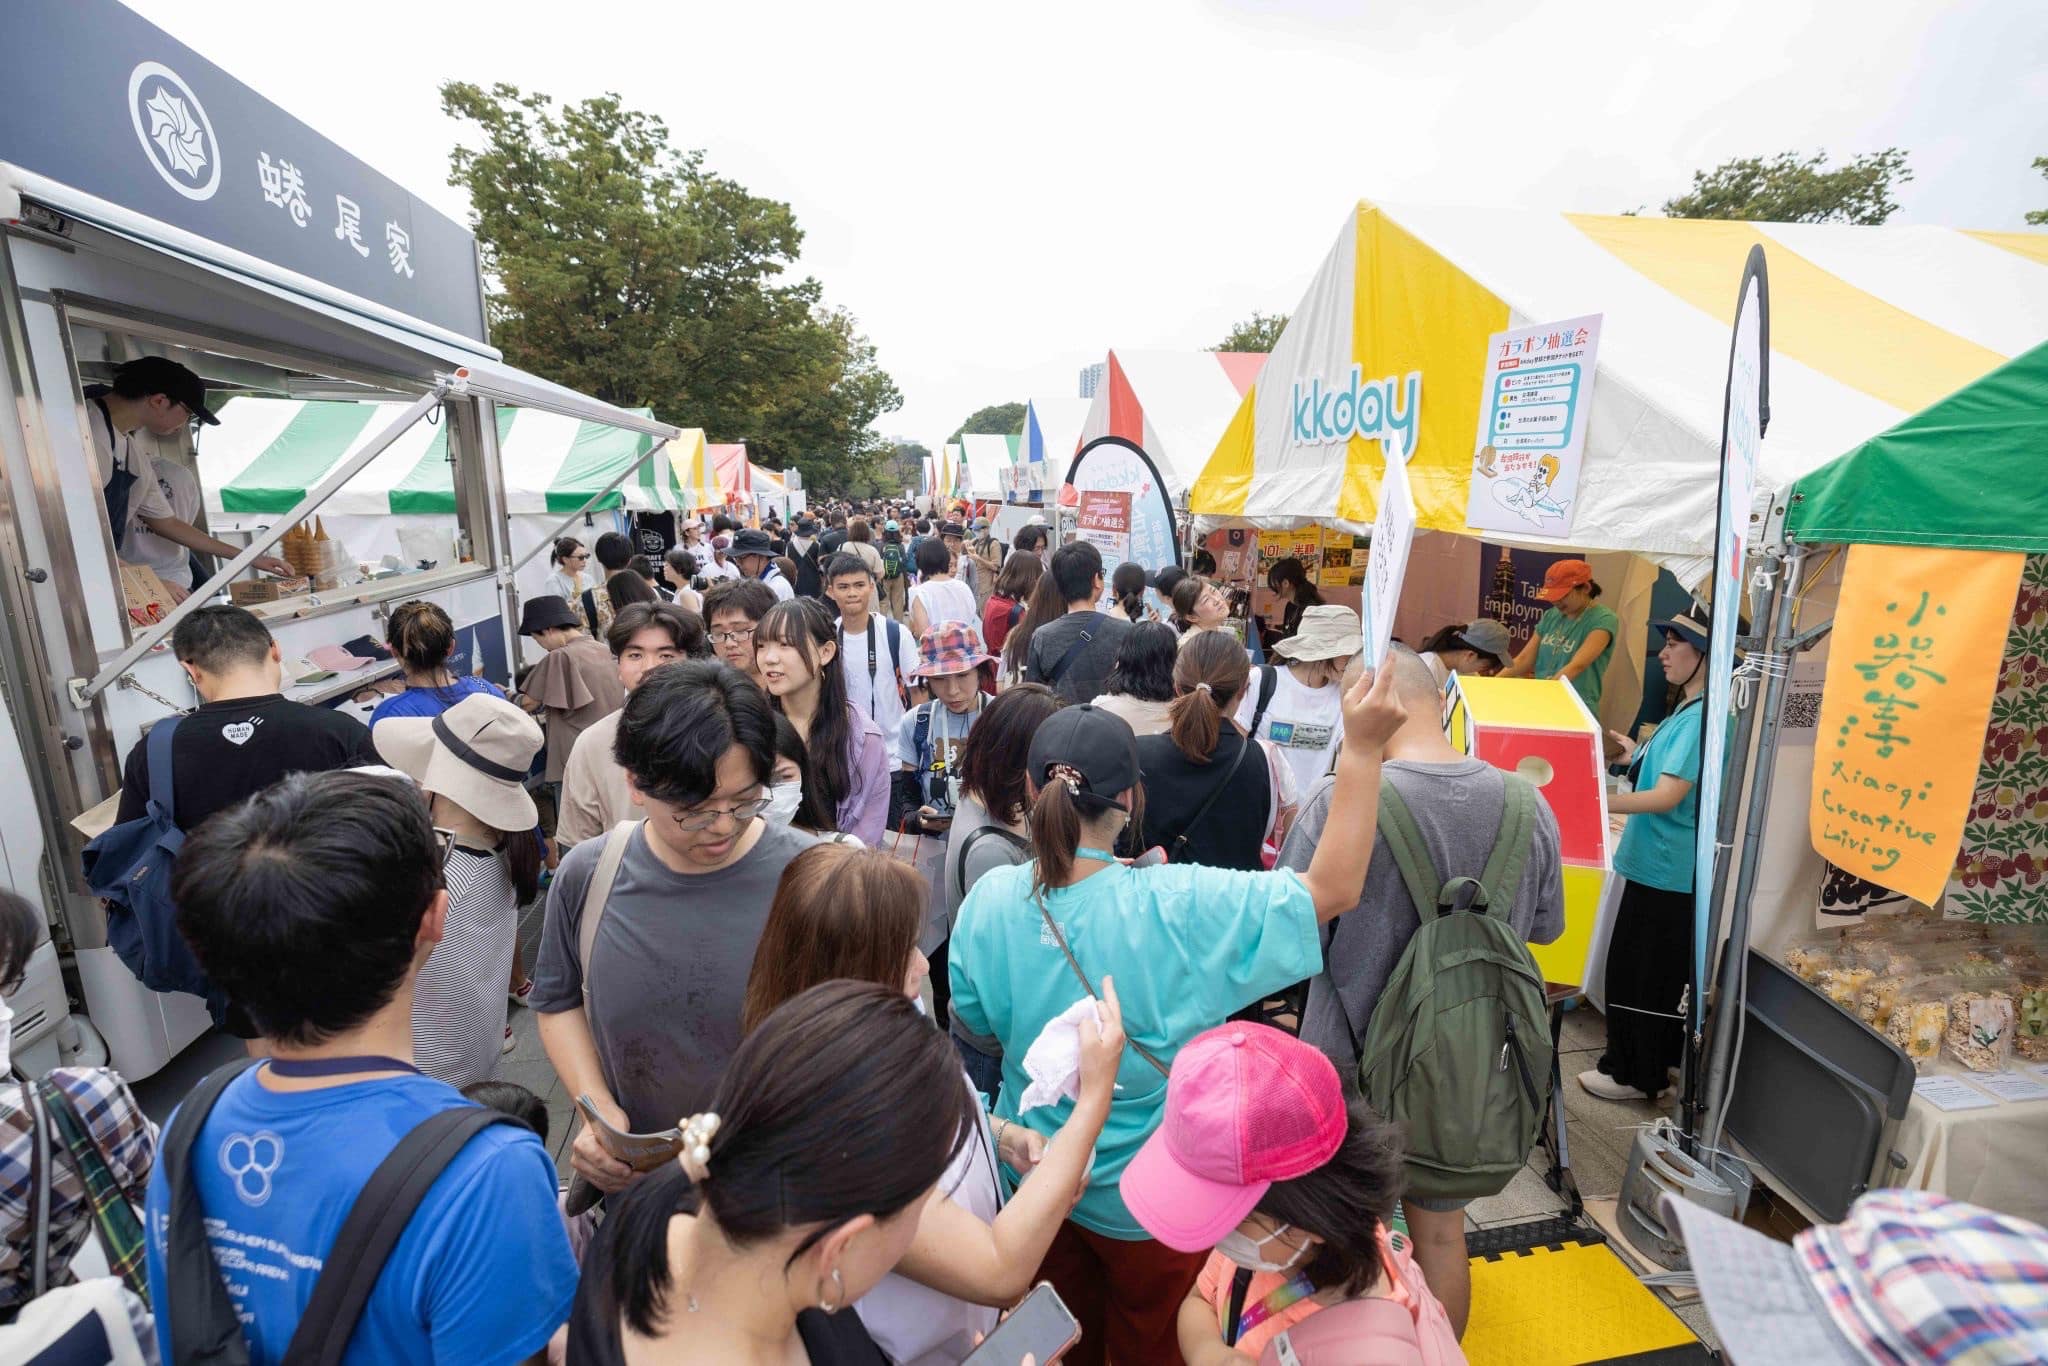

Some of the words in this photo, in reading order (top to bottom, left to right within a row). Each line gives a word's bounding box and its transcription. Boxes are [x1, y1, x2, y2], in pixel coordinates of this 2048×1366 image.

[1500, 327, 1589, 357] ガラポン抽選会
[1293, 366, 1419, 462] kkday
[1484, 595, 1543, 621] Employm
[1500, 621, 1529, 641] old
[227, 725, 250, 734] HUMAN
[1822, 789, 1937, 846] Creative
[1823, 823, 1901, 872] Living
